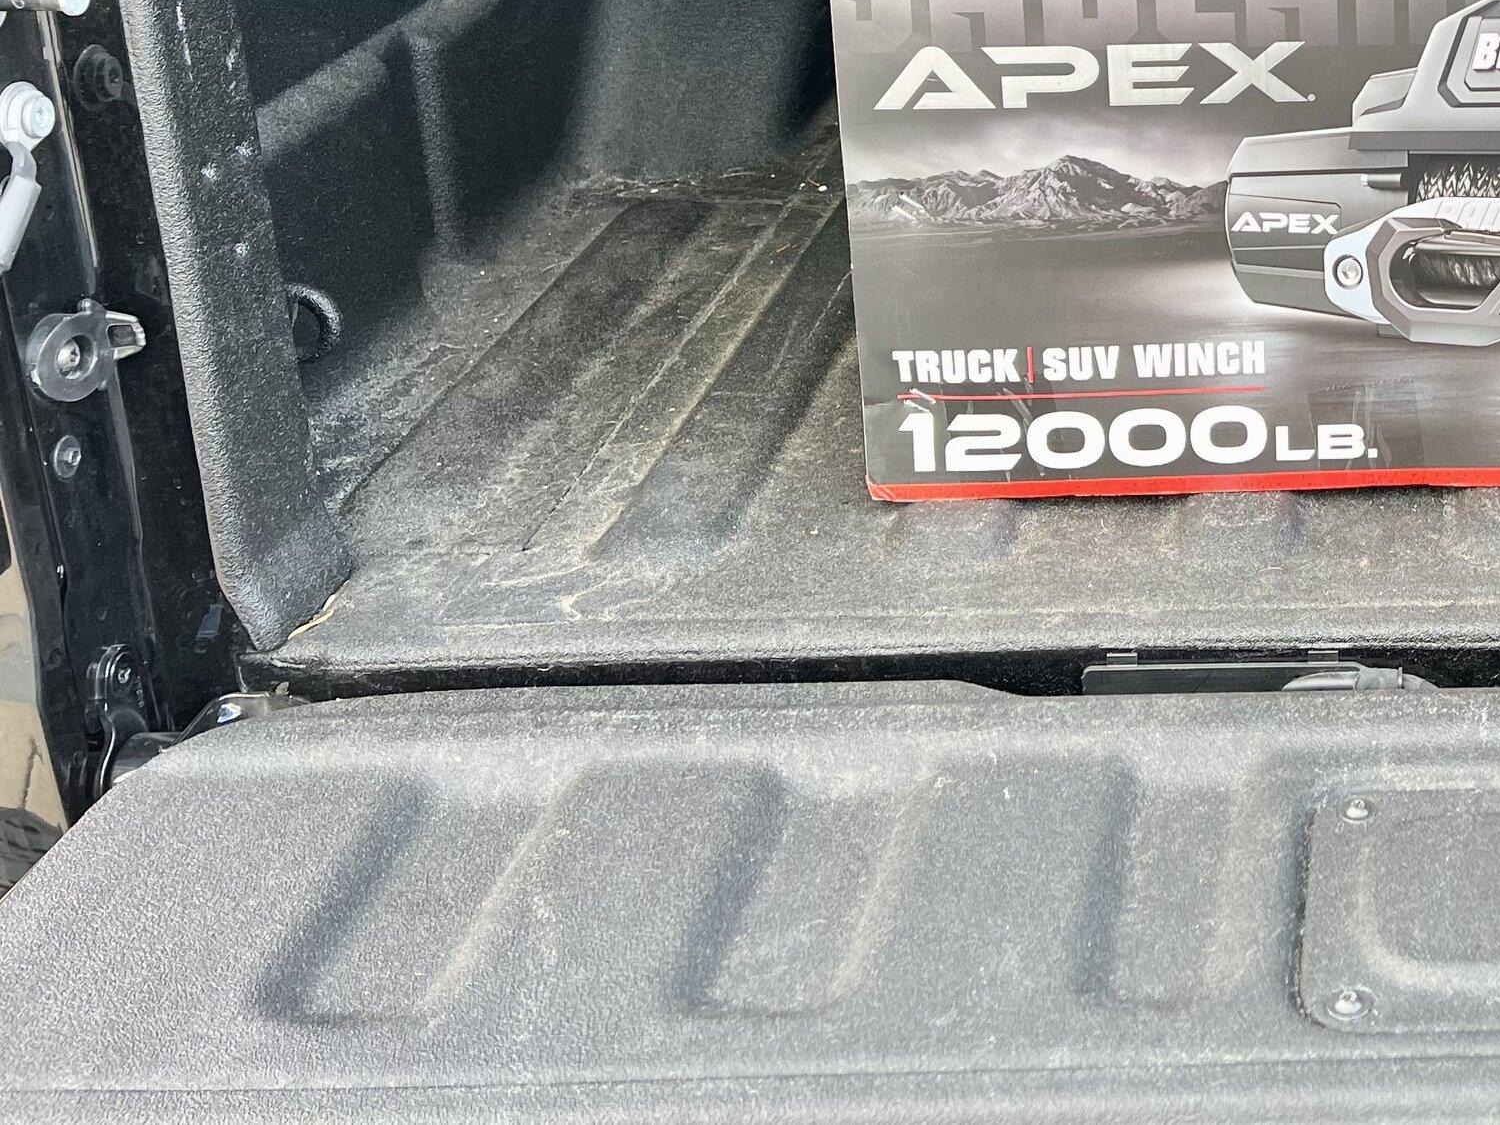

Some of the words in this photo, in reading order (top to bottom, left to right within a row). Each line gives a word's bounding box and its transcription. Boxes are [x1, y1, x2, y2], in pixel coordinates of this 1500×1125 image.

[873, 40, 1310, 111] APEX
[1230, 210, 1340, 236] APEX
[891, 349, 1021, 384] TRUCK
[1042, 345, 1121, 381] SUV
[1134, 340, 1266, 376] WINCH
